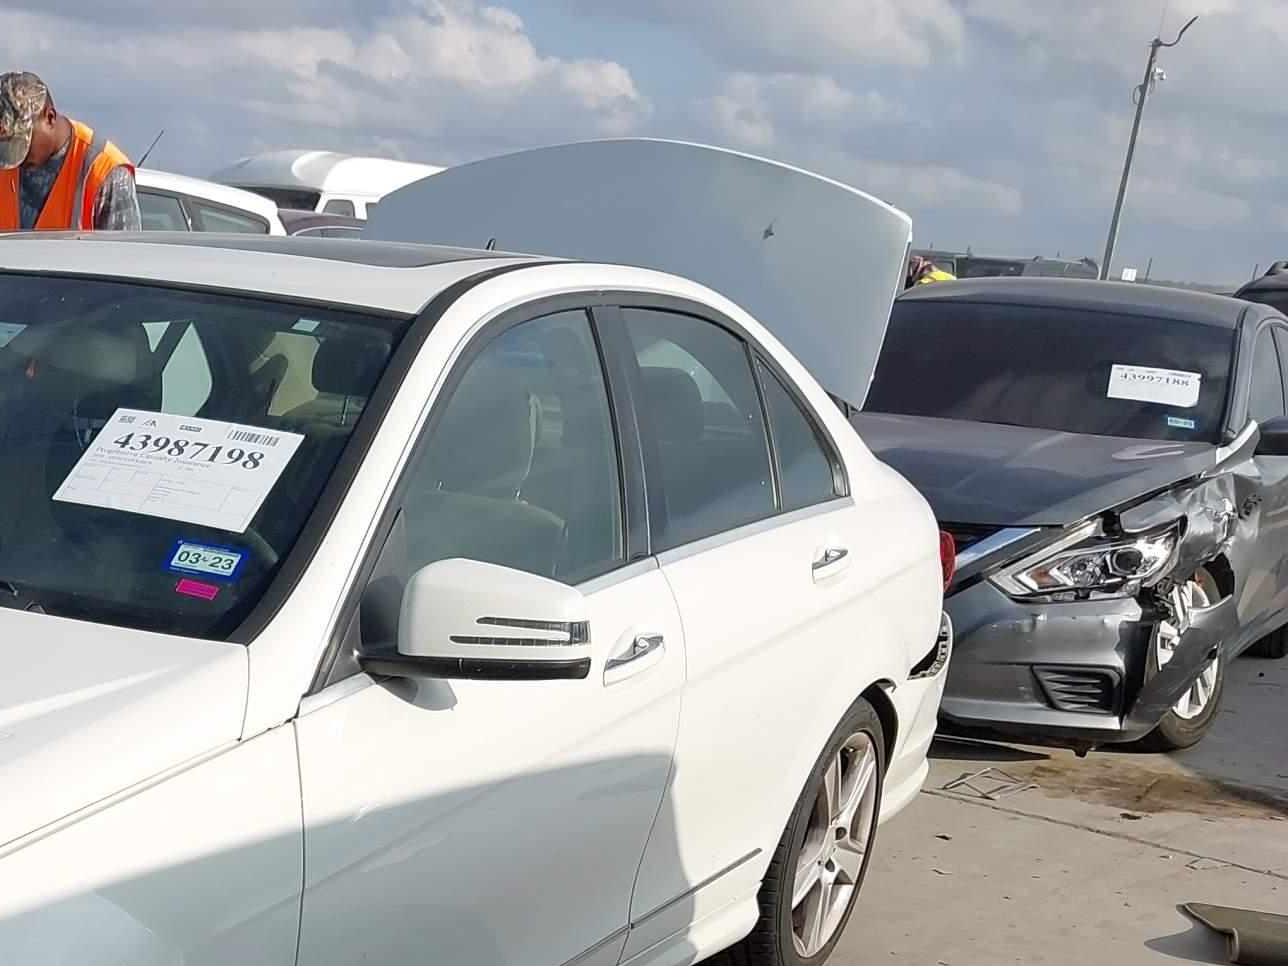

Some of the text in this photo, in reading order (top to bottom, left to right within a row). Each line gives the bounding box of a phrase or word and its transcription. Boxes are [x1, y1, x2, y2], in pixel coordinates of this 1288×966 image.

[1119, 372, 1189, 386] 43997188
[95, 446, 139, 458] Progressive
[140, 452, 173, 464] Casualty
[174, 458, 212, 469] Insurance
[112, 431, 265, 471] 43987198
